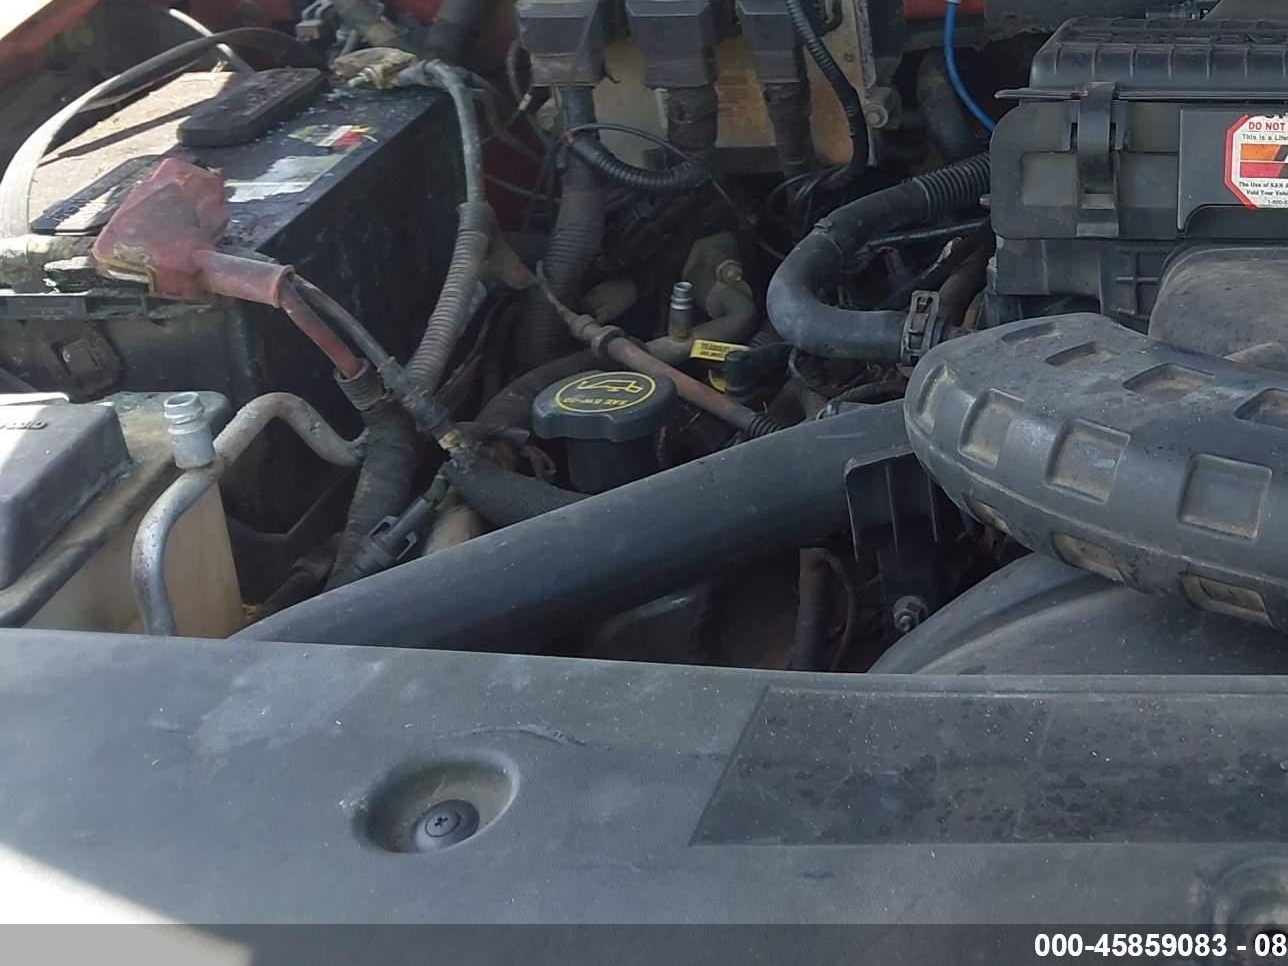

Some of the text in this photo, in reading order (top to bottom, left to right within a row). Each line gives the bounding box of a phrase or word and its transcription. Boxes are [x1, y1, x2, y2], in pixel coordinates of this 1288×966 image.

[1248, 121, 1262, 130] DO
[1265, 122, 1286, 131] NOT
[603, 398, 628, 406] SAE
